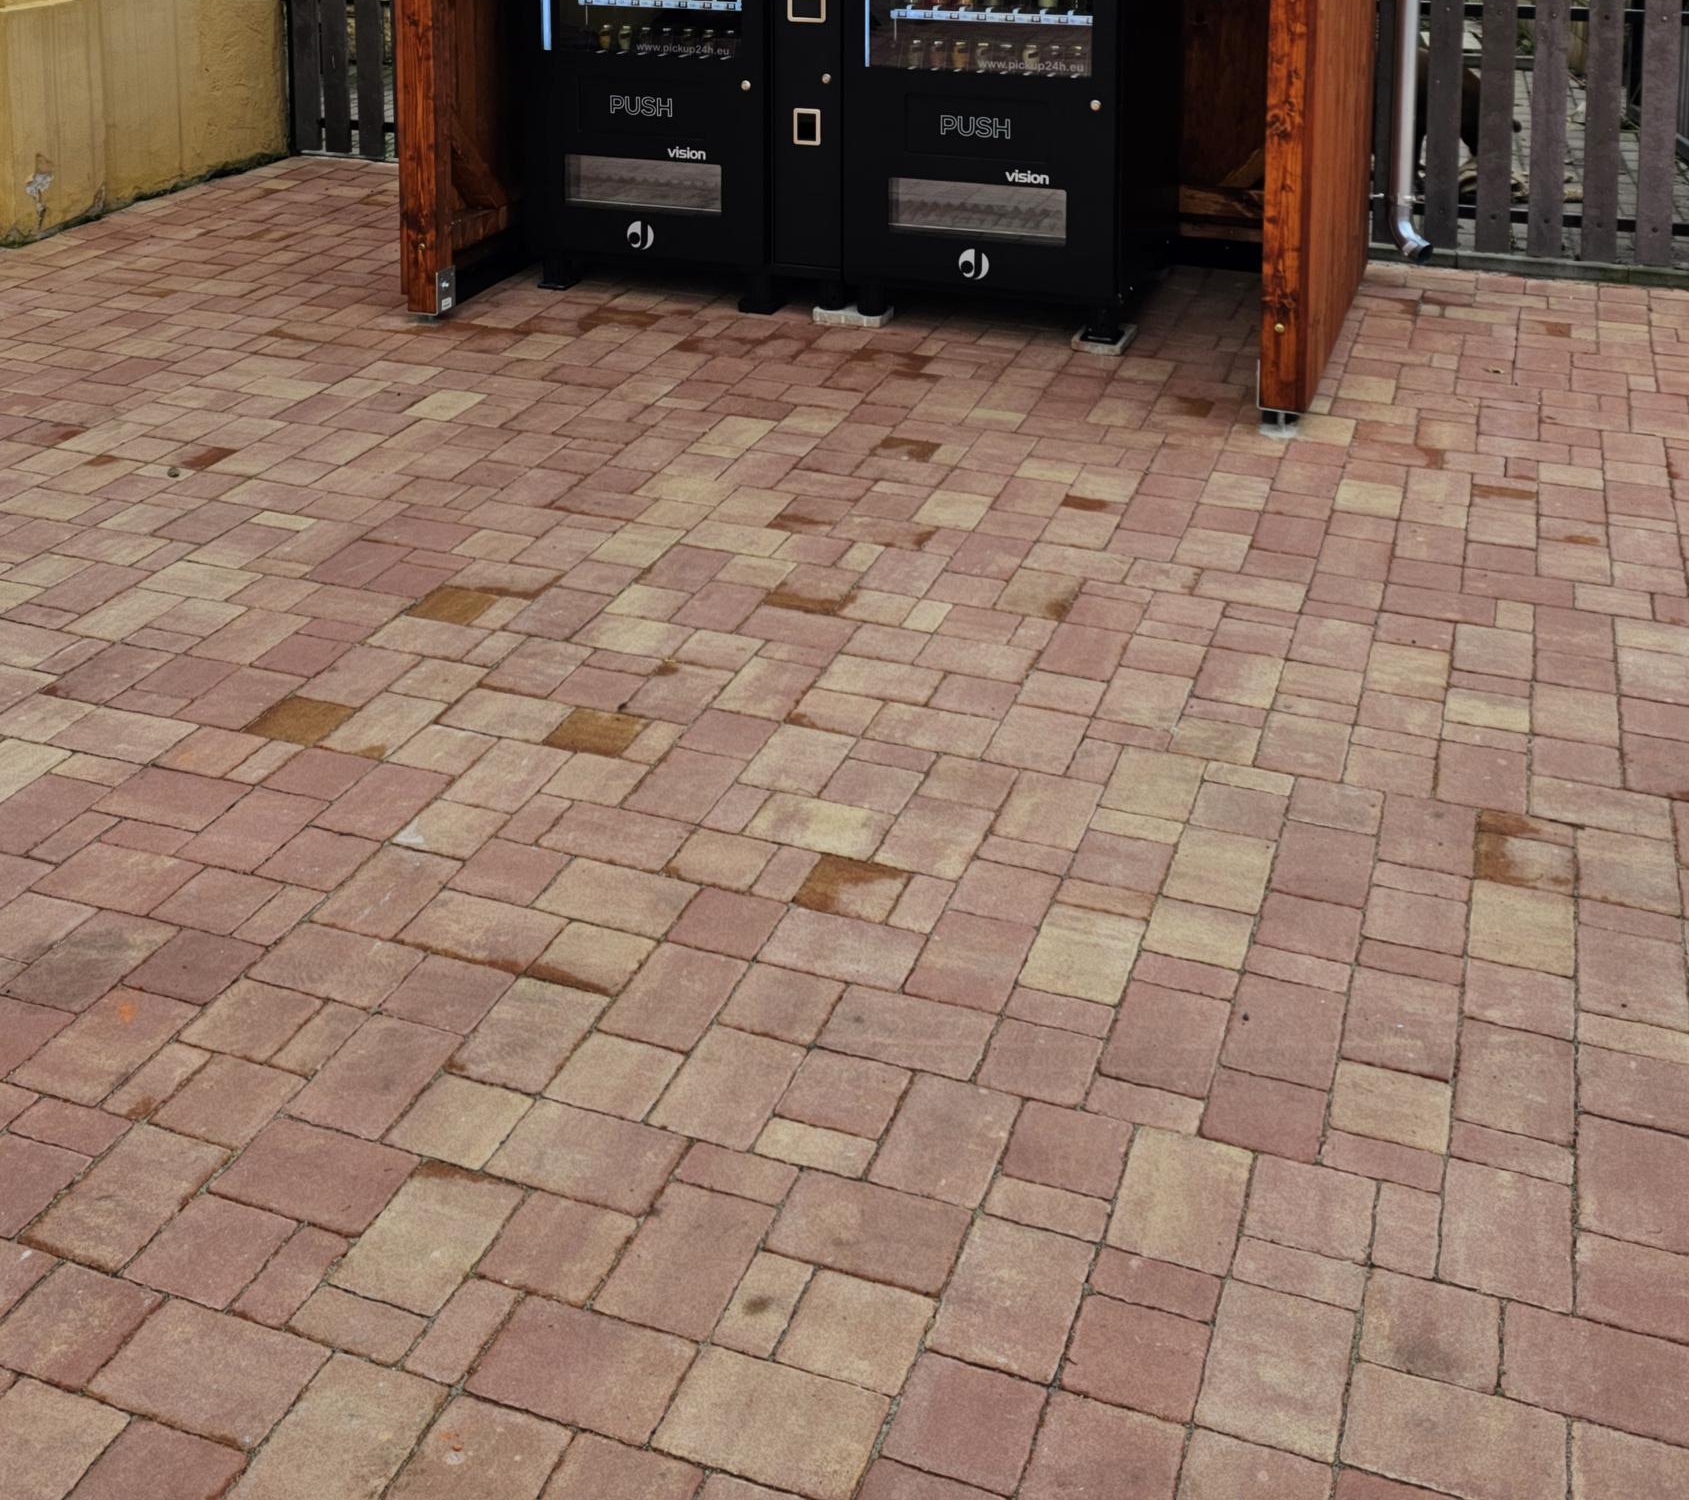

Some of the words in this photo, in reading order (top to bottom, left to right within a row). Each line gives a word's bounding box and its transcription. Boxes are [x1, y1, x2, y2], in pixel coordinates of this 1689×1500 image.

[636, 43, 730, 56] www.pickup24h.eu
[609, 94, 673, 117] PUSH
[940, 115, 1011, 139] PUSH
[667, 146, 706, 160] vision
[1005, 169, 1049, 185] vision
